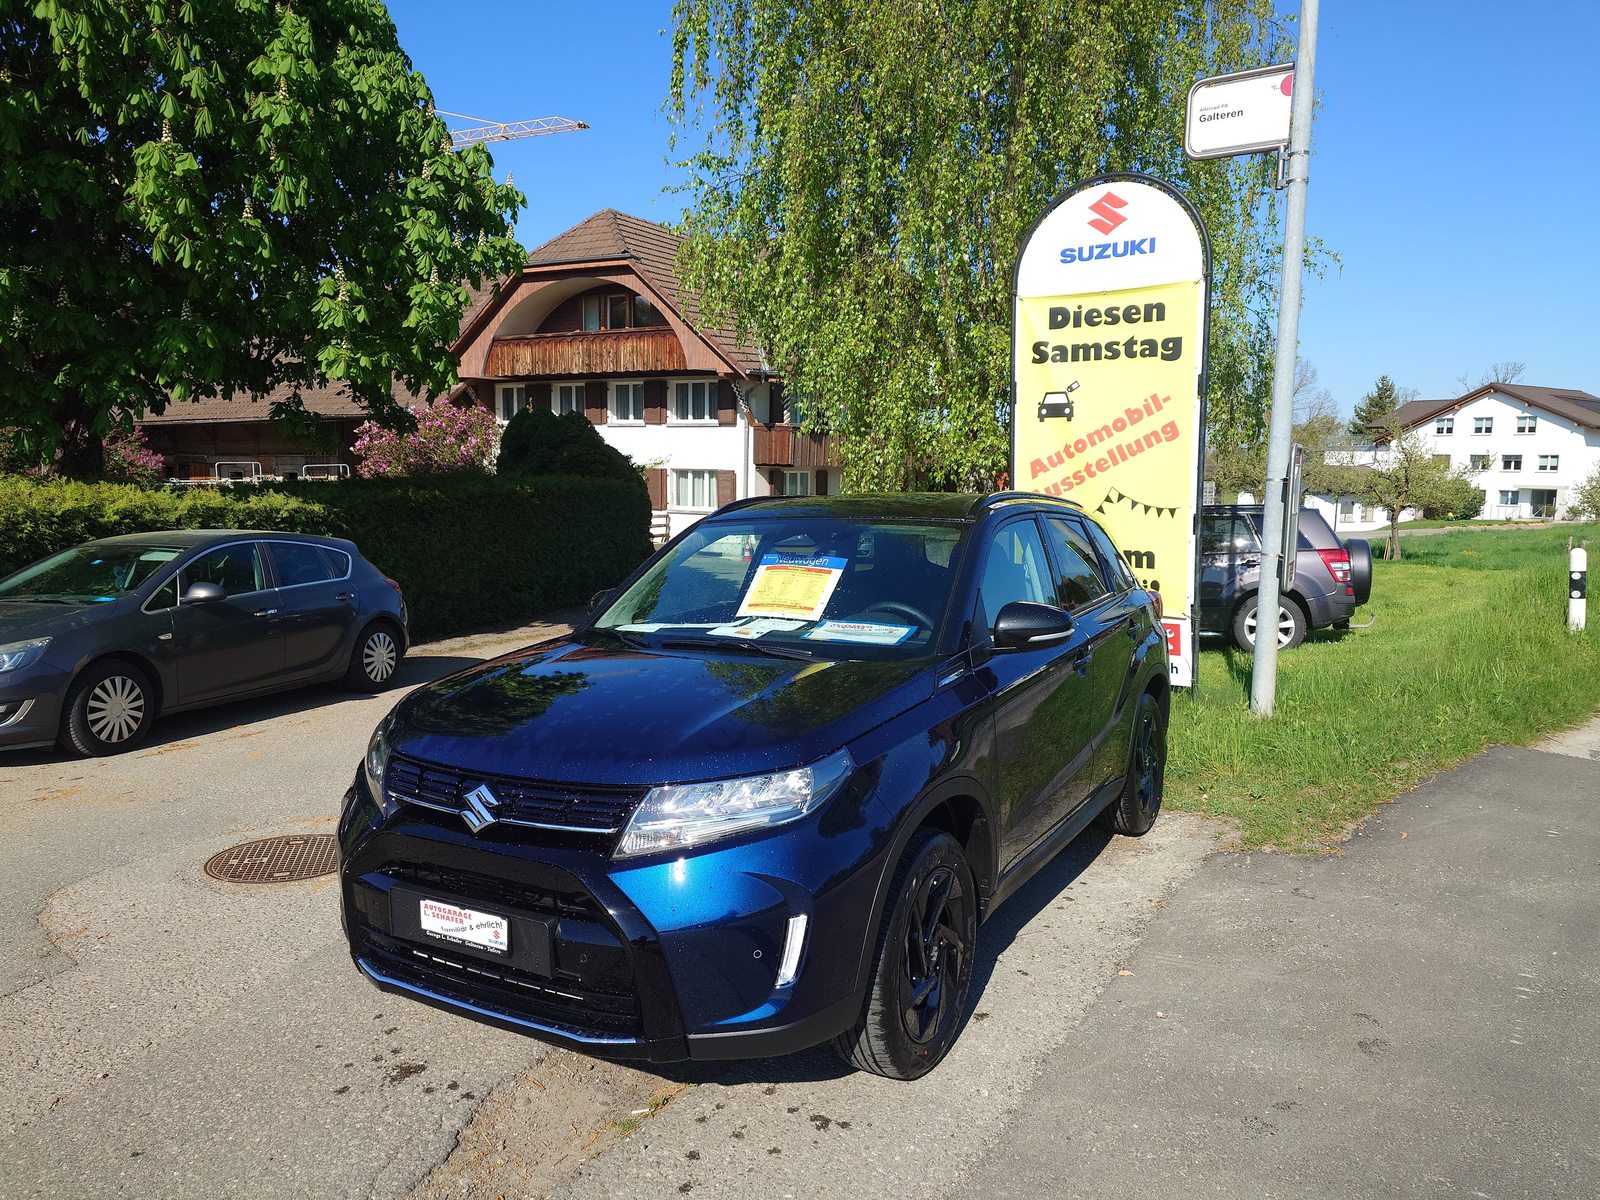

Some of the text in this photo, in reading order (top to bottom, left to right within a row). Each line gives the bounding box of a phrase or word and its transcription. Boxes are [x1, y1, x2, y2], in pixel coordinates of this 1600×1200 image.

[1199, 109, 1244, 123] Galteren
[1059, 237, 1156, 264] SUZUKI
[1048, 302, 1166, 330] Diesen
[1031, 335, 1183, 365] Samstag
[1029, 393, 1172, 480] Automobil-
[1031, 420, 1180, 497] usstellung
[775, 554, 830, 567] Neuwagen
[423, 903, 472, 920] AUTOGARAGE
[476, 920, 503, 930] ehrlich!
[488, 938, 506, 946] SUZUKI
